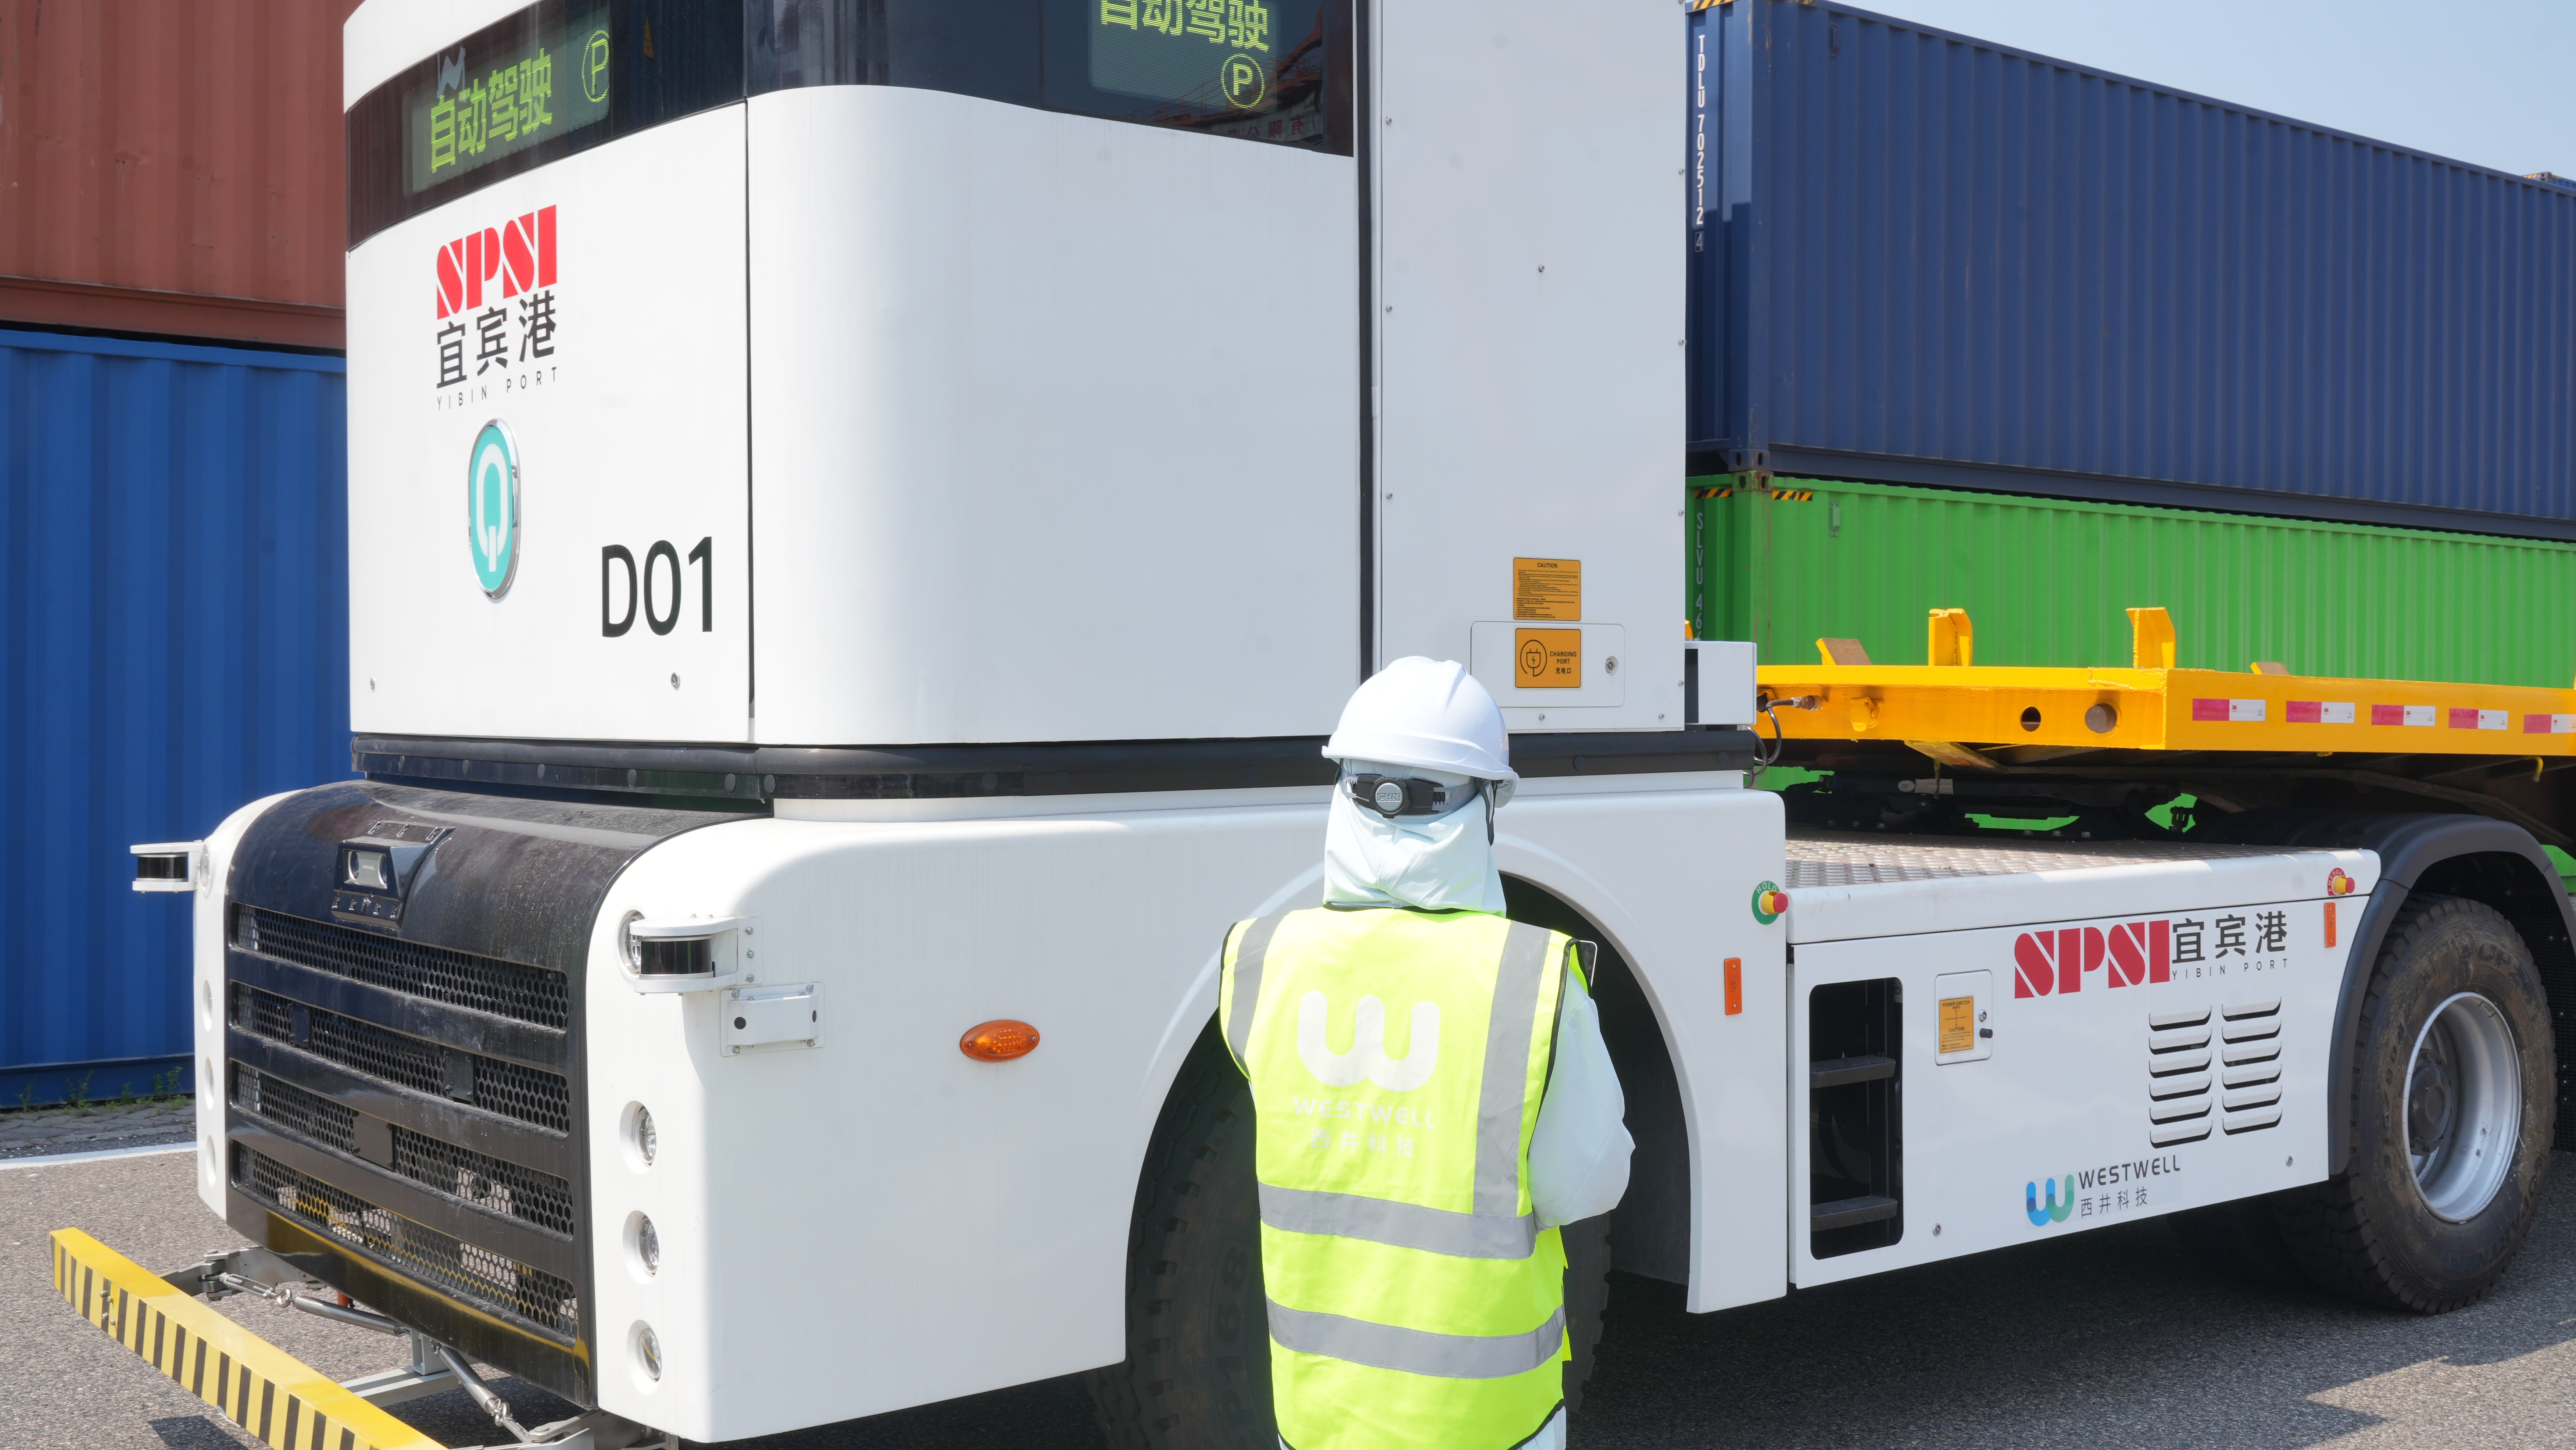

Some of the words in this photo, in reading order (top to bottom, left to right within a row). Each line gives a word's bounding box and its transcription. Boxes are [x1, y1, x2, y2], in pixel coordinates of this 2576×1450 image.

[1697, 35, 1706, 108] TDLU
[431, 47, 552, 173] 自动驾驶
[1696, 114, 1705, 225] 702512
[437, 204, 557, 320] SPSI
[1695, 233, 1703, 251] 4
[436, 289, 557, 389] 宜宾港
[437, 385, 487, 411] YIBIN
[507, 366, 557, 393] PORT
[1756, 882, 1777, 894] HOLD
[2328, 870, 2344, 892] EMERGE
[2171, 910, 2288, 965] 宜宾港
[2014, 919, 2170, 999] SPSI
[2172, 965, 2226, 981] YIBIN
[2244, 958, 2288, 972] PORT
[1293, 1096, 1435, 1129] WESTWELL
[1310, 1128, 1415, 1160] 西井科技
[2079, 1154, 2180, 1189] WESTWELL
[2080, 1186, 2148, 1218] 西井科技
